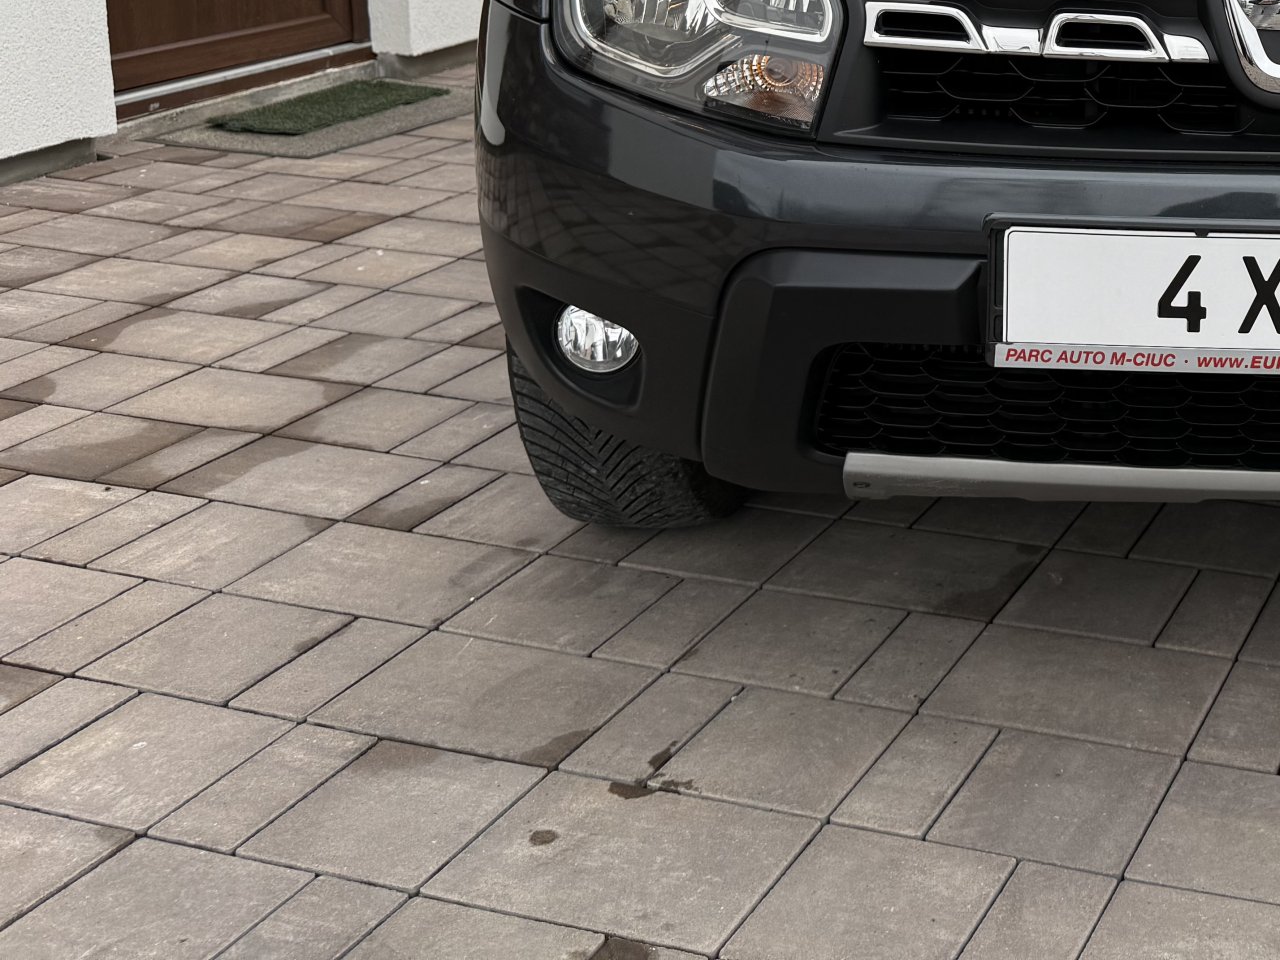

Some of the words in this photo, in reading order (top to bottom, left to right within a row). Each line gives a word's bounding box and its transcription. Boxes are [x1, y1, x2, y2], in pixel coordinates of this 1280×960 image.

[1157, 255, 1206, 333] 4
[1005, 348, 1053, 363] PARC
[1056, 350, 1105, 365] AUTO
[1110, 352, 1176, 367] M-CIUC
